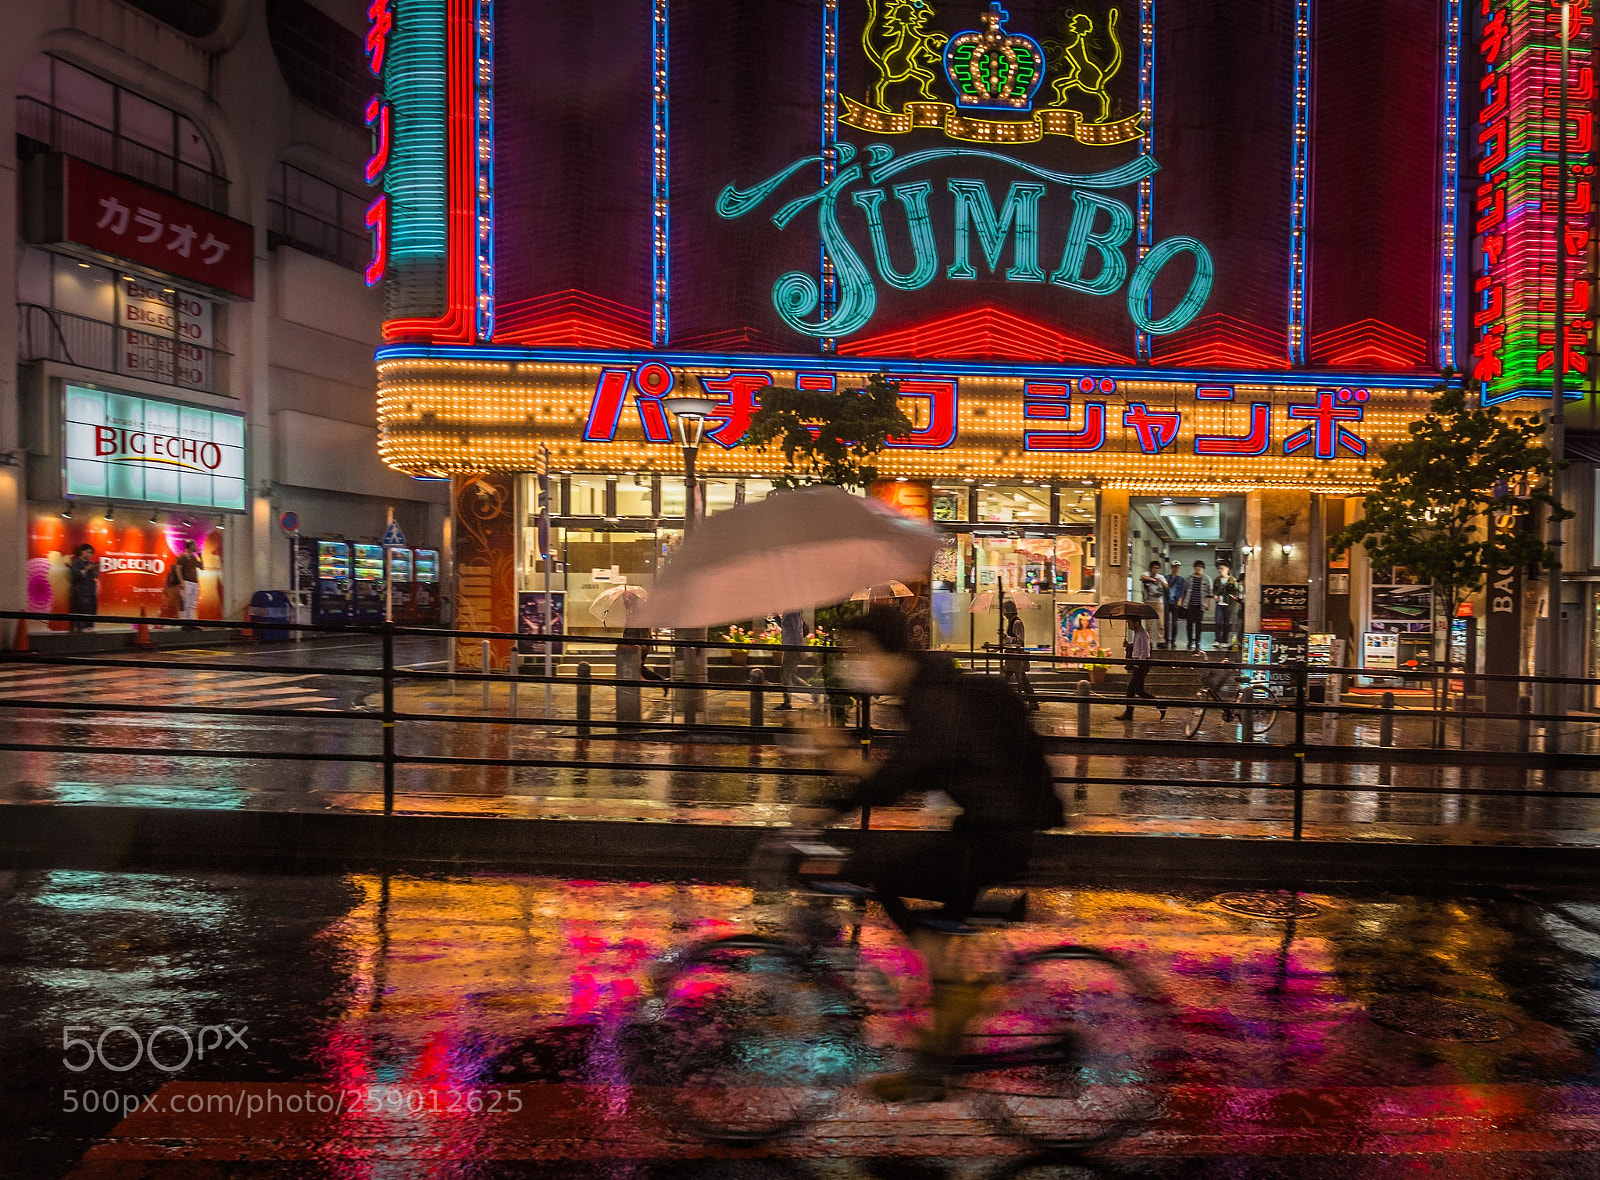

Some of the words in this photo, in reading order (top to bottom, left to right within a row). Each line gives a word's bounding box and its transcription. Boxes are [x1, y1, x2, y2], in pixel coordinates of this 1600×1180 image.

[97, 196, 231, 265] カラオケ
[715, 142, 1215, 336] JUMBO
[126, 281, 157, 299] BIG
[158, 290, 203, 317] ECHO
[126, 303, 156, 323] BIG
[158, 312, 203, 339] ECHO
[1023, 376, 1367, 460] ジャンボ
[95, 425, 147, 457] BIG
[152, 434, 222, 470] ECHO
[99, 556, 127, 573] BIG
[127, 558, 166, 574] ECHO
[1492, 514, 1516, 614] BAS
